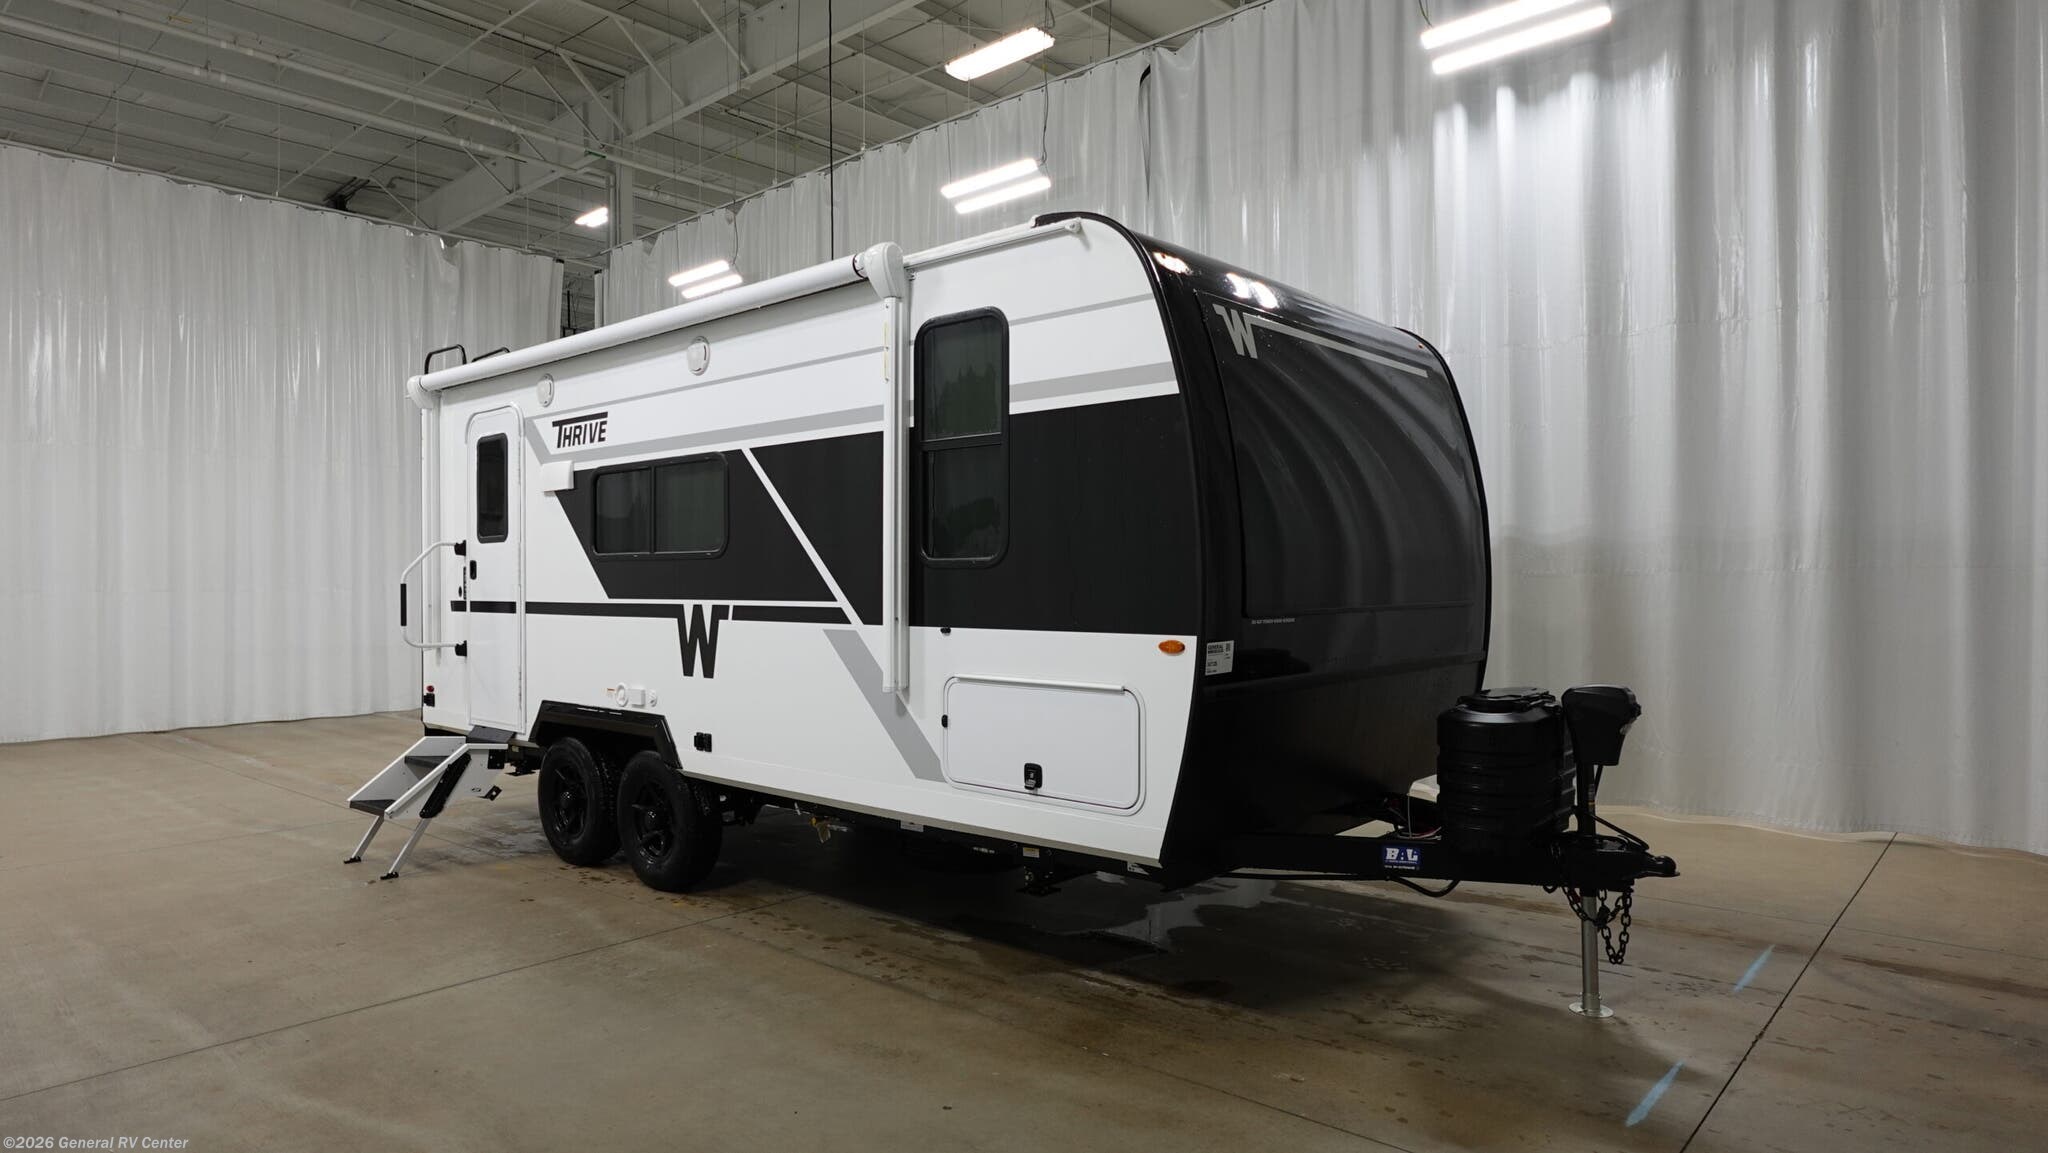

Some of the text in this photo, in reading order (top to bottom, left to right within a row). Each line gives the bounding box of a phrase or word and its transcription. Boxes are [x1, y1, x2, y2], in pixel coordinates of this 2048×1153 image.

[1212, 303, 1258, 359] W
[552, 411, 608, 448] THRIVE
[677, 603, 729, 679] W
